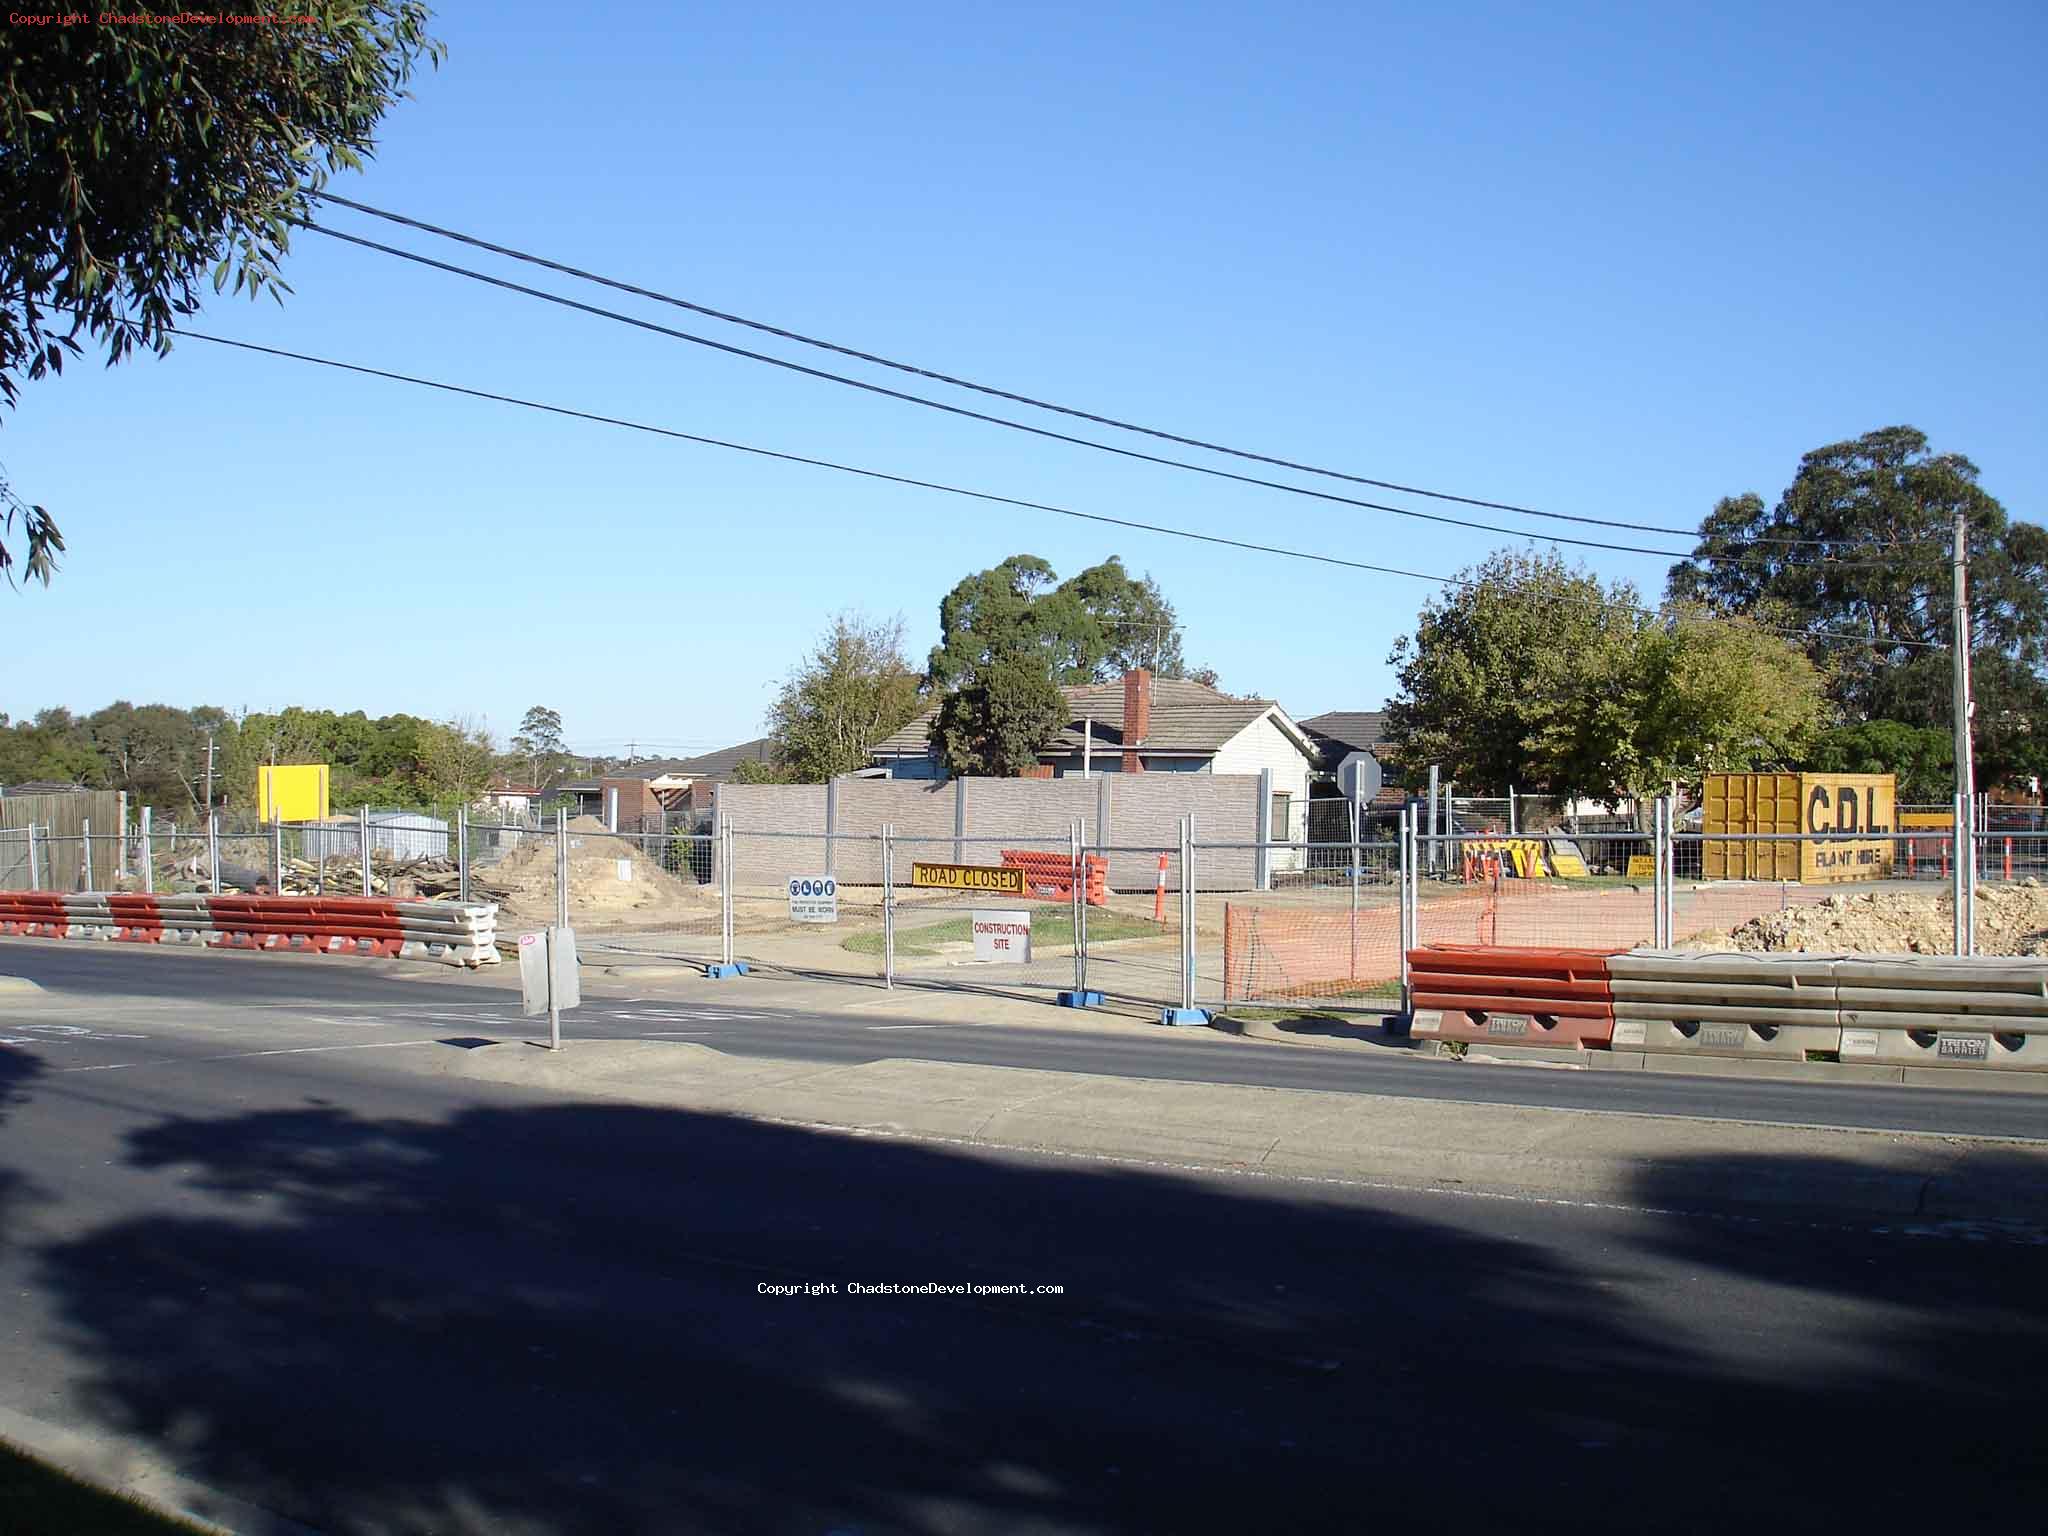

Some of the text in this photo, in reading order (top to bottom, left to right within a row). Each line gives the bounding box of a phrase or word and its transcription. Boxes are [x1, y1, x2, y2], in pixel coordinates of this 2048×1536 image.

[1856, 848, 1881, 865] HIRE
[920, 867, 1018, 888] ROAD CLOSED
[974, 921, 1029, 936] CONSTRUCTION
[993, 938, 1011, 951] SITE
[1940, 1038, 1986, 1048] TRITON
[1941, 1046, 1985, 1056] BARRIER
